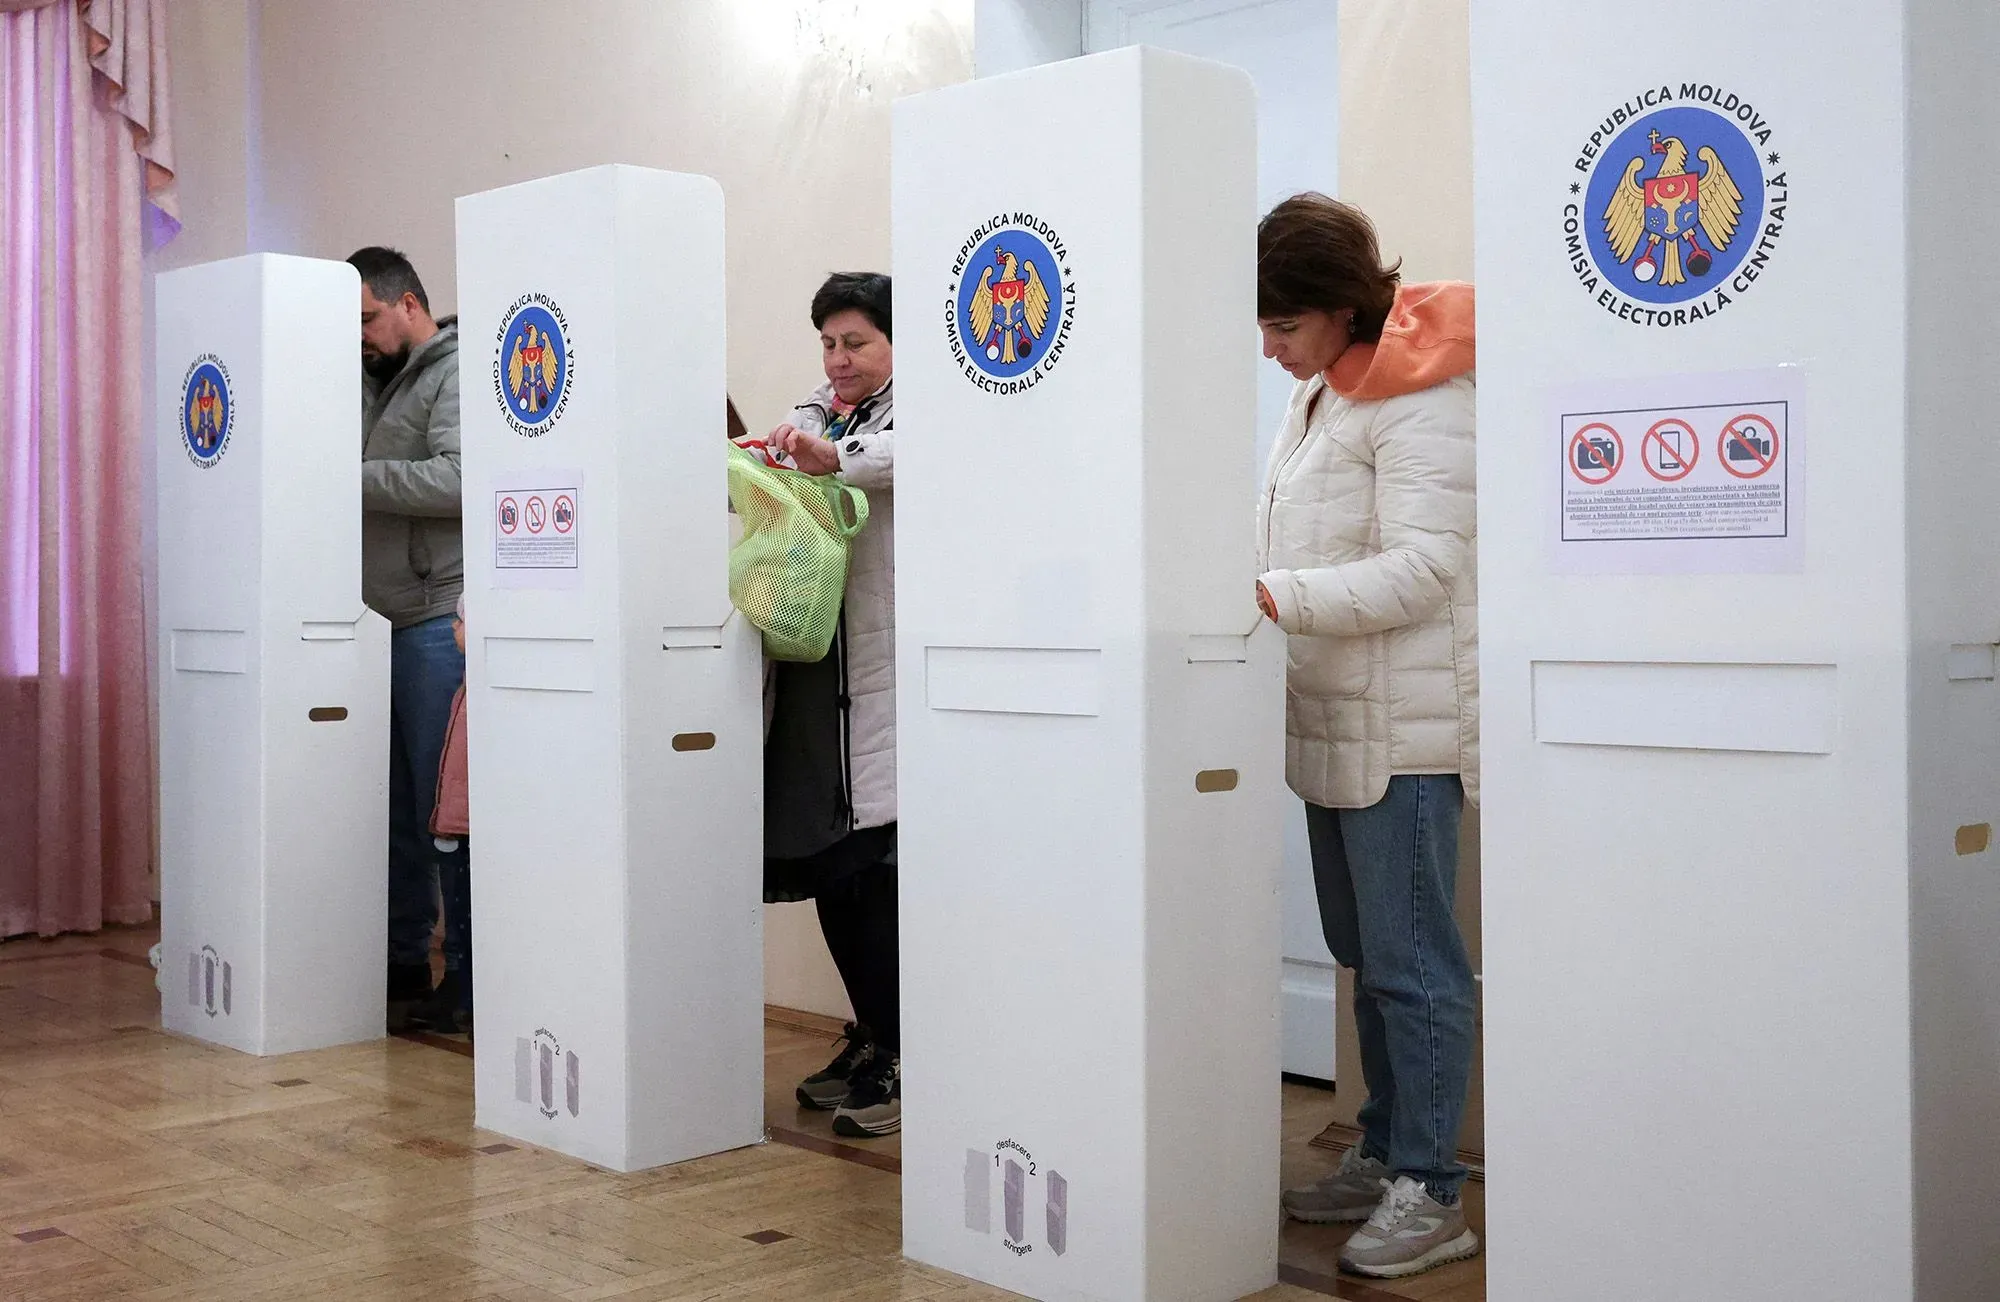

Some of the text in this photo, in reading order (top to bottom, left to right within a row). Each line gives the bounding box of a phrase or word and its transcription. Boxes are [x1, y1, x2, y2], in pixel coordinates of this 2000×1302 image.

[1575, 83, 1773, 173] REPUBLICA MOLDOVA
[952, 212, 1067, 276] REPUBLICA MOLDOVA
[1563, 171, 1788, 328] COMISIA ELECTORALĂ CENTRALĂ
[496, 292, 569, 342] REPUBLICA MOLDOVA
[945, 282, 1076, 396] COMISIA ELECTORALĂ CENTRALĂ
[182, 353, 231, 391] REPUBLICA MOLDOVA
[493, 360, 507, 416] COMISIA
[179, 406, 188, 451] COMISIA
[534, 1040, 560, 1056] 1 2
[995, 1154, 1036, 1176] 1 2
[996, 1138, 1031, 1160] desfacere
[1003, 1239, 1032, 1256] stringere
